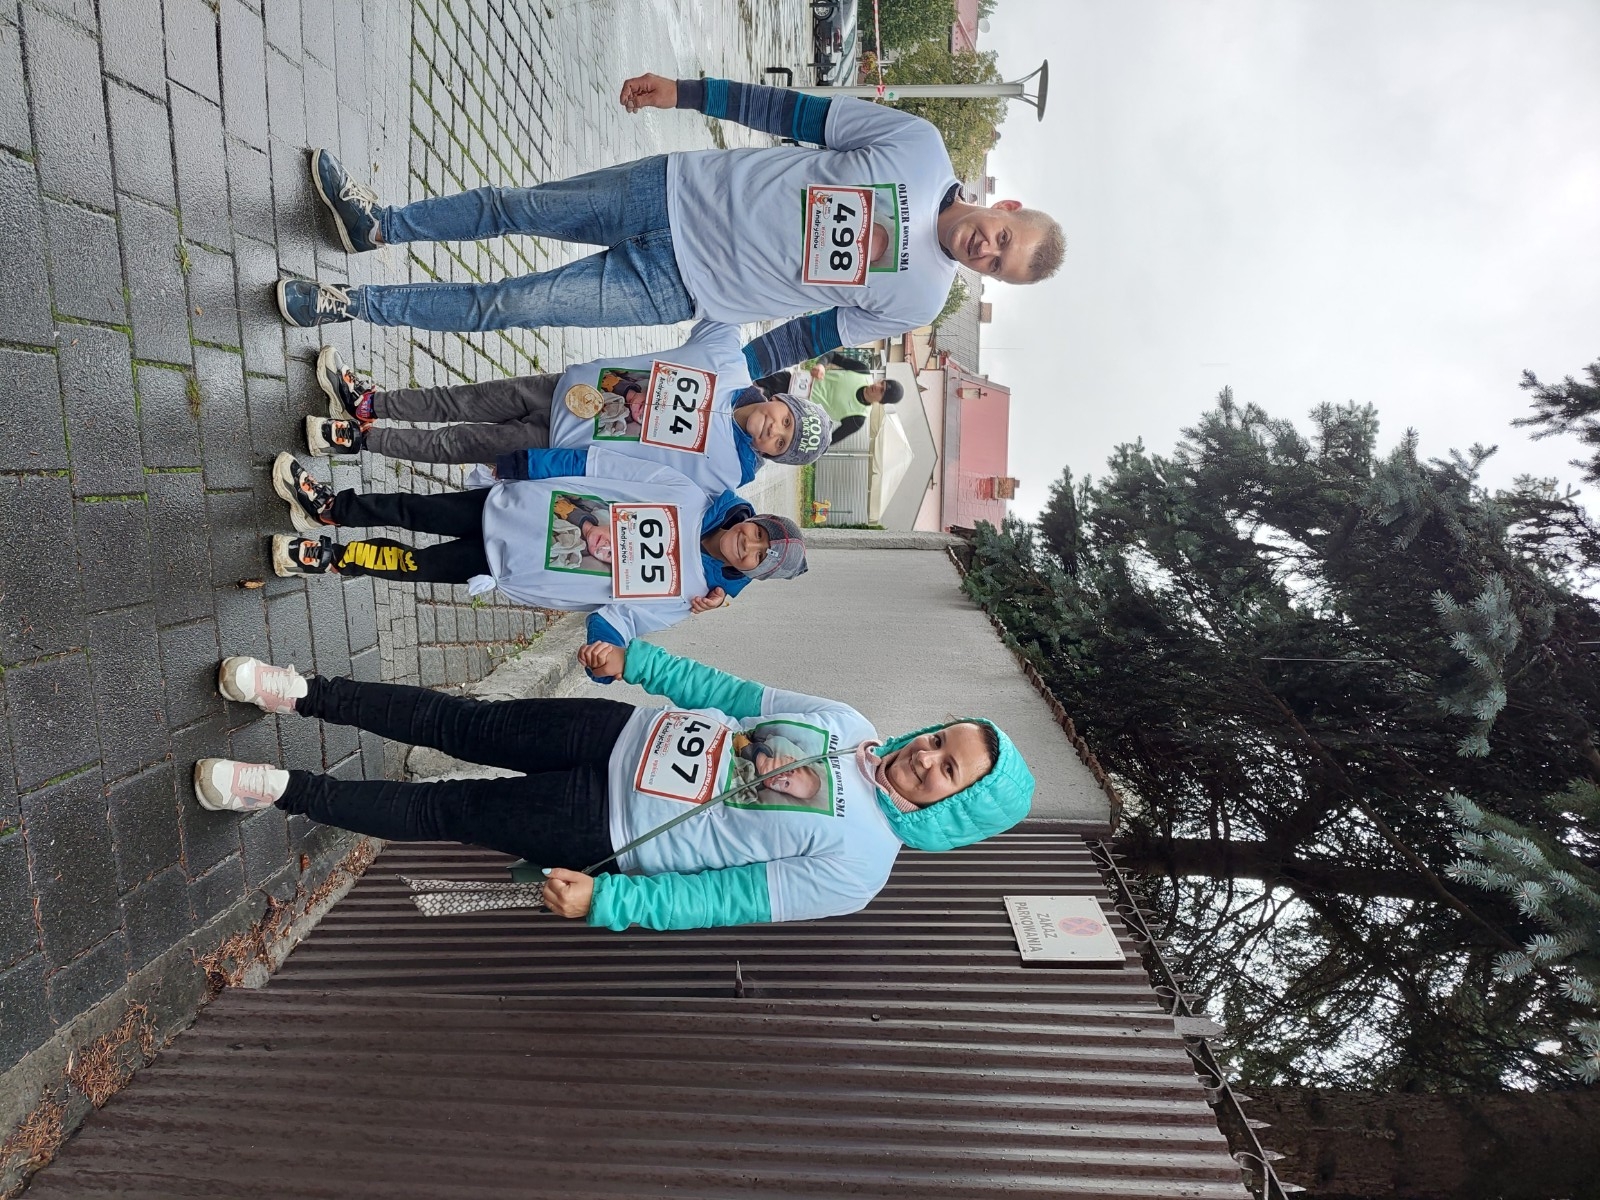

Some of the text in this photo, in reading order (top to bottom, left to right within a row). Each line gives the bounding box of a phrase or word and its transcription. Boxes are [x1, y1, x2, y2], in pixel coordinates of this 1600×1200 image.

[829, 203, 856, 271] 498
[898, 183, 910, 271] OLIWIER KONTRA SMA
[669, 377, 700, 435] 624
[798, 437, 809, 453] LIKE
[805, 416, 822, 453] COOL
[639, 518, 665, 583] 625
[670, 720, 711, 784] 497
[835, 771, 844, 795] KONTRA
[835, 797, 846, 818] SMA
[1015, 902, 1042, 951] PARKOWANIA
[1036, 914, 1057, 938] ZAKAZ
